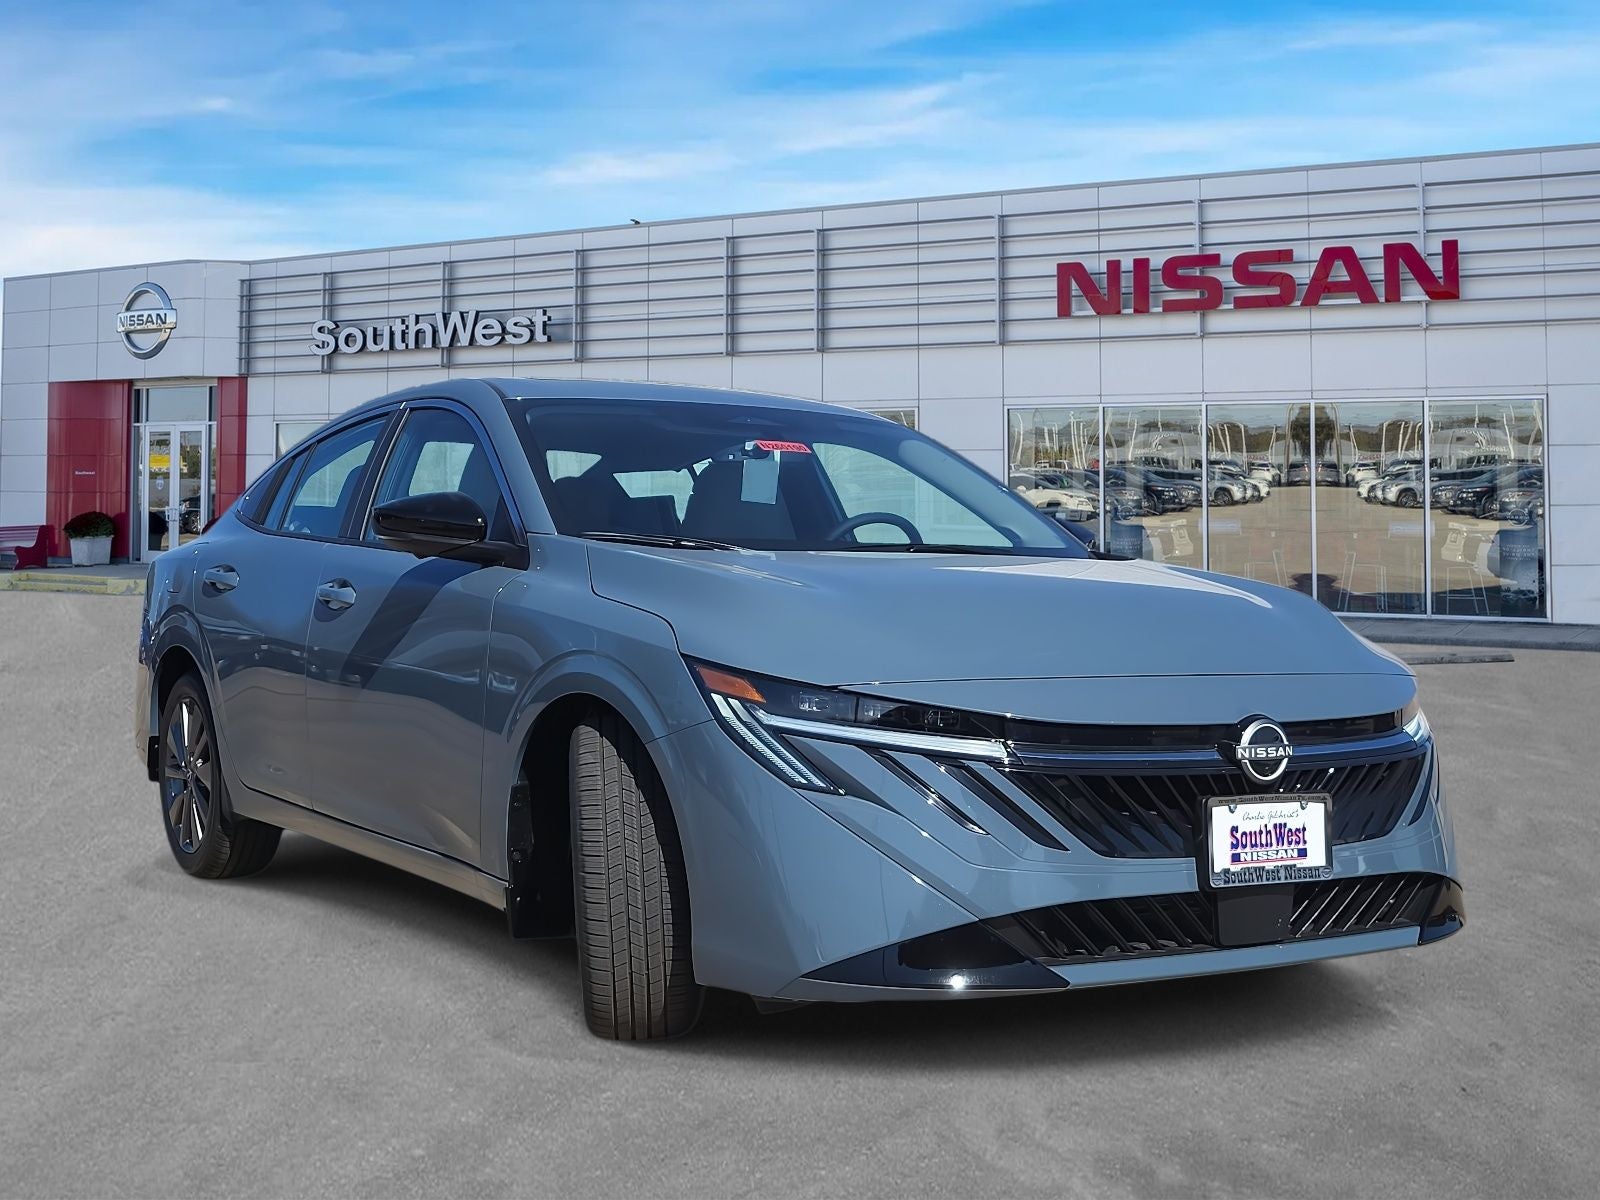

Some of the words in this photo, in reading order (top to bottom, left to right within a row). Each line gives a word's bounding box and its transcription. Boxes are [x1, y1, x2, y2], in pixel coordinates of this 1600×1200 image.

[1057, 239, 1460, 318] NISSAN
[119, 313, 168, 328] NISSAN
[309, 308, 552, 356] SouthWest
[1237, 746, 1293, 758] NISSAN
[1230, 822, 1307, 850] SouthWest
[1240, 848, 1297, 861] NISSAN
[1223, 865, 1281, 884] SouthWest
[1284, 864, 1321, 881] Nissan
